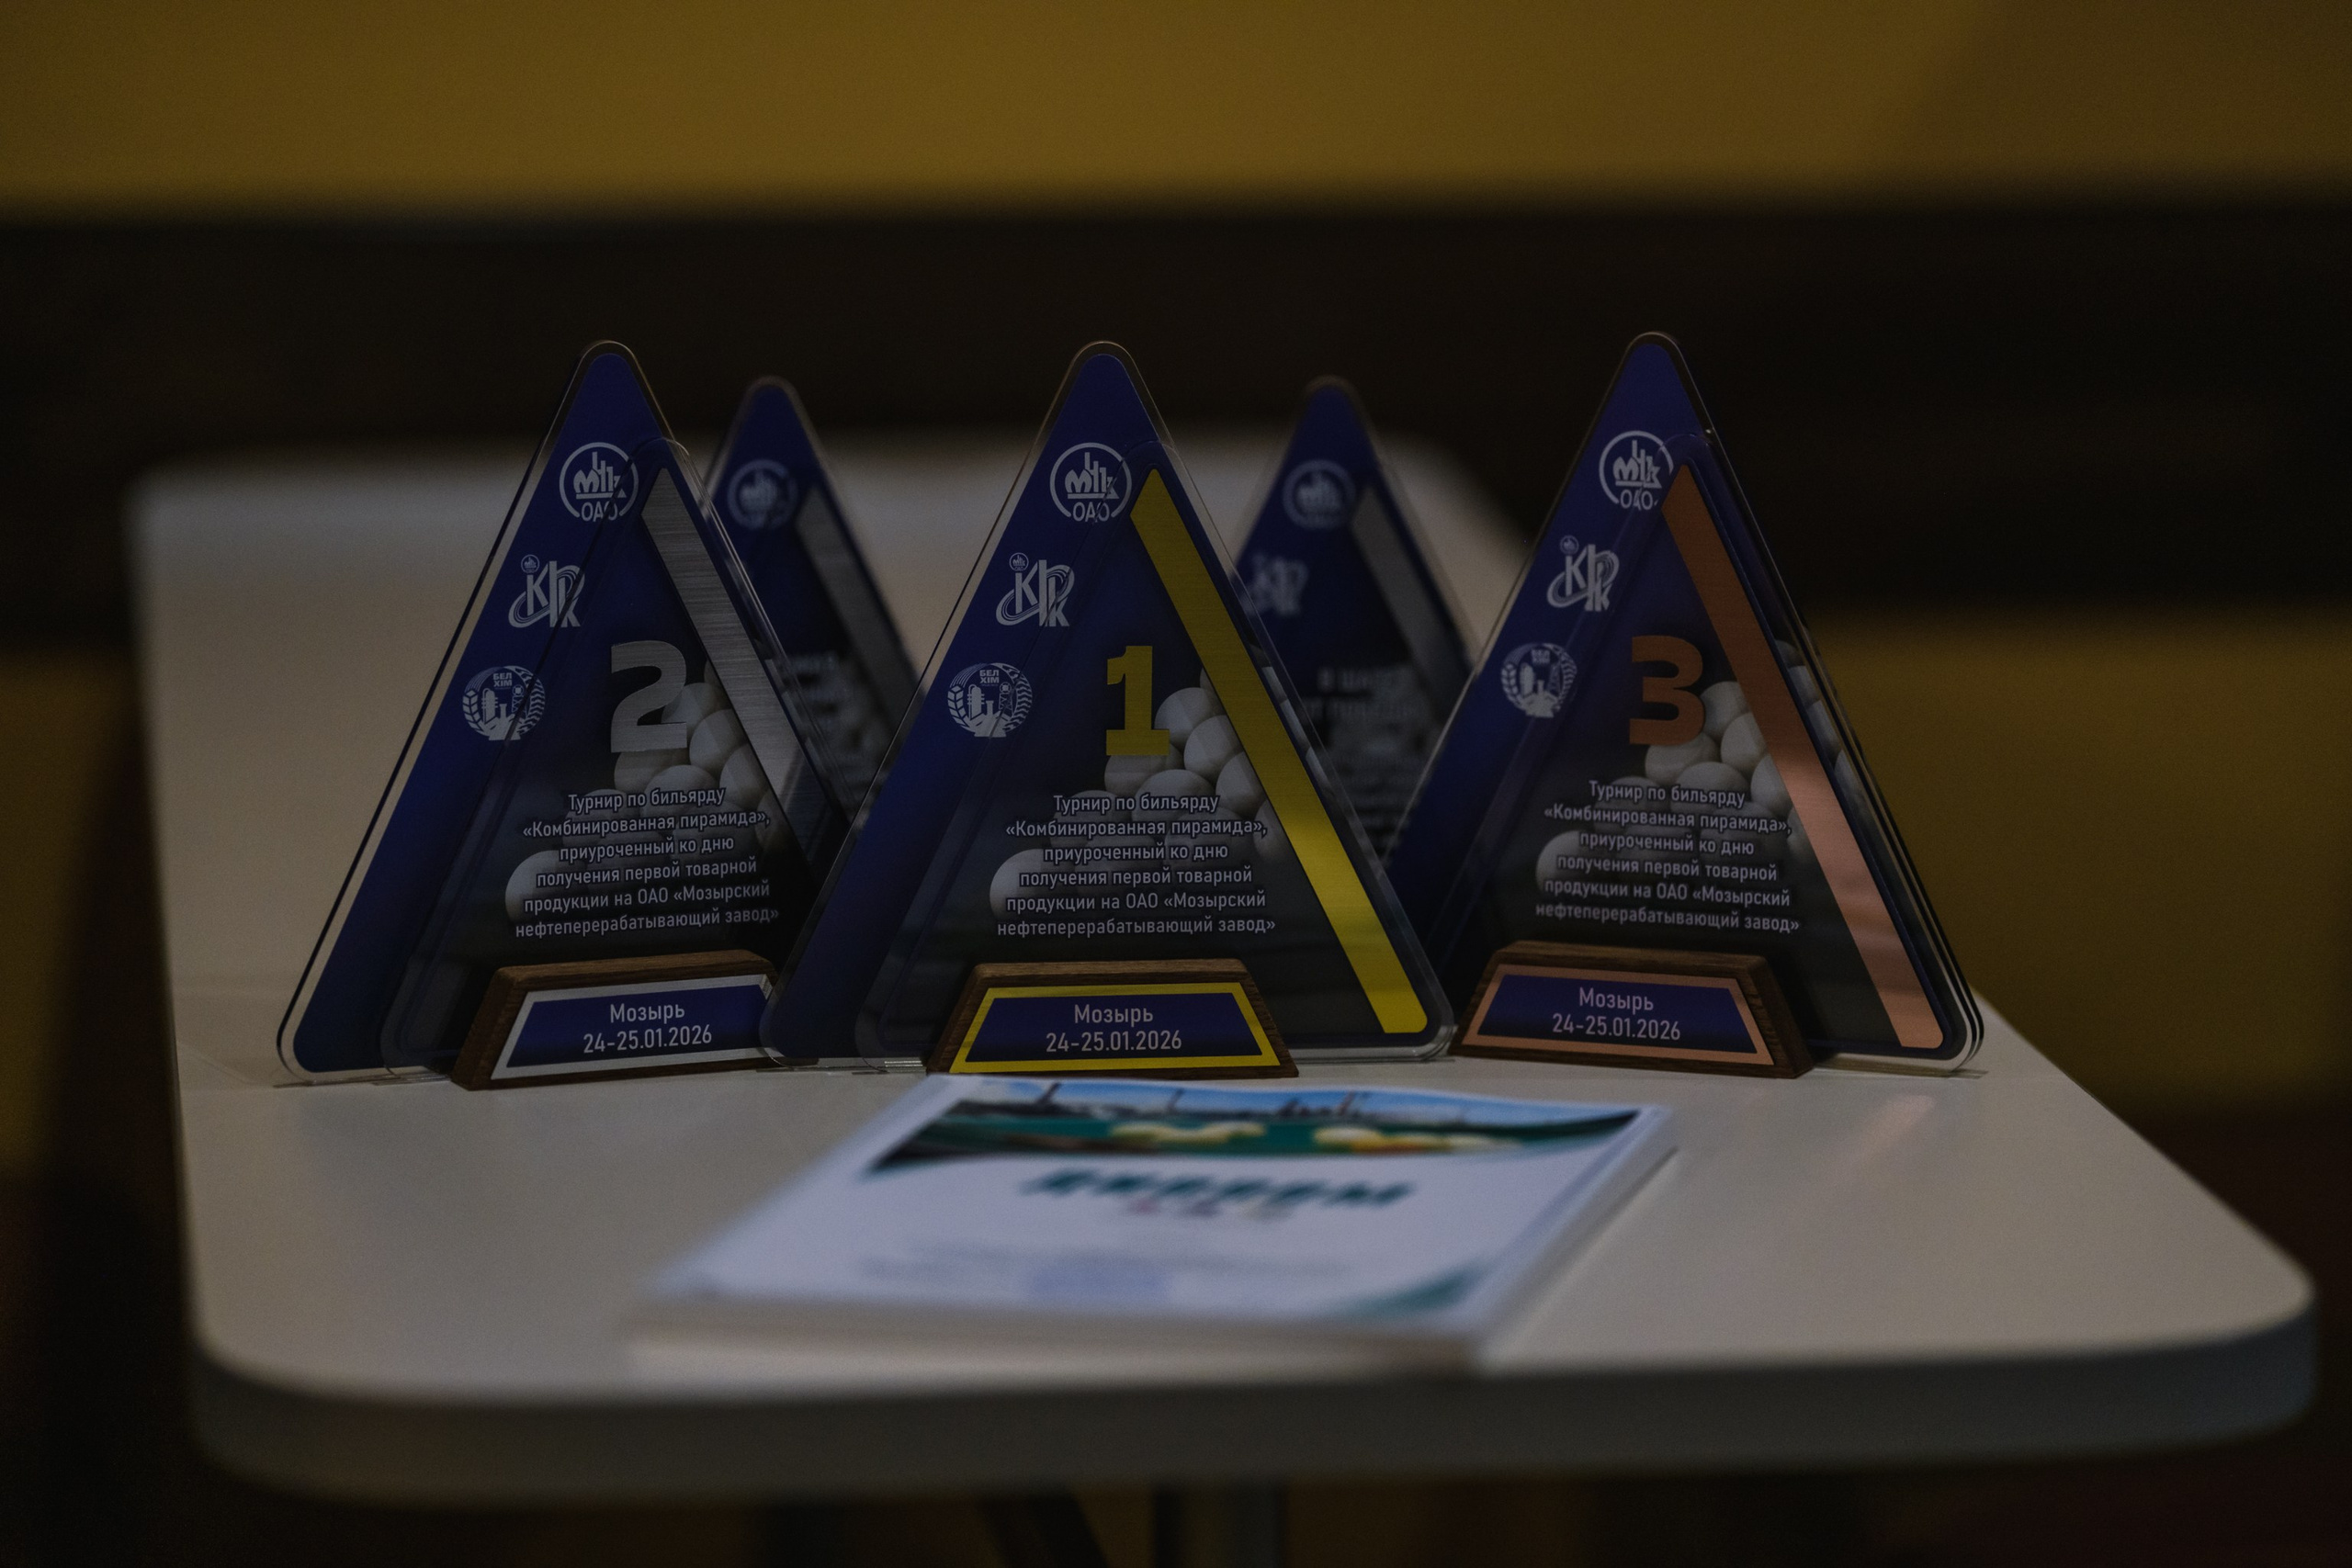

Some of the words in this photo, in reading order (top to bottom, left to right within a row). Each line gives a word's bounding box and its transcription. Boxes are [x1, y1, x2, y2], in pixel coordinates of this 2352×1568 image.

[611, 640, 688, 753] 2
[1106, 645, 1170, 756] 1
[1629, 635, 1706, 746] 3
[568, 793, 623, 816] Турнир
[628, 794, 646, 808] по
[650, 787, 726, 807] бильярду
[1054, 795, 1111, 815] Турнир
[1115, 797, 1135, 810] по
[1140, 792, 1219, 813] бильярду
[1589, 780, 1643, 803] Турнир
[1647, 786, 1666, 801] по
[1671, 784, 1745, 808] бильярду
[523, 814, 675, 838] «Комбинированная
[680, 810, 770, 832] пирамида»,
[1006, 818, 1166, 839] «Комбинированная
[1170, 818, 1268, 838] пирамида»,
[1544, 803, 1695, 827] «Комбинированная
[1700, 814, 1792, 835] пирамида»,
[560, 833, 674, 863] приуроченный
[679, 838, 696, 852] ко
[701, 837, 735, 854] дню
[1044, 841, 1165, 864] приуроченный
[1170, 846, 1188, 858] ко
[1193, 844, 1228, 860] дню
[1580, 830, 1693, 852] приуроченный
[1700, 840, 1716, 853] ко
[1721, 840, 1755, 856] дню
[537, 867, 620, 888] получения
[625, 857, 680, 883] первой
[684, 855, 757, 878] товарной
[1020, 872, 1107, 888] получения
[1112, 866, 1171, 887] первой
[1176, 864, 1252, 886] товарной
[1558, 855, 1639, 873] получения
[1645, 858, 1700, 878] первой
[1705, 863, 1777, 882] товарной
[524, 892, 609, 915] продукции
[614, 893, 632, 907] на
[638, 887, 668, 905] ОАО
[673, 879, 770, 902] «Мозырский
[1006, 896, 1095, 914] продукции
[1102, 896, 1120, 908] на
[1125, 893, 1159, 908] ОАО
[1163, 889, 1266, 909] «Мозырский
[1544, 879, 1628, 897] продукции
[1633, 886, 1652, 898] на
[1657, 884, 1688, 899] ОАО
[1692, 886, 1791, 908] «Мозырский
[514, 907, 720, 938] нефтеперерабатывающий
[725, 907, 779, 924] завод»
[997, 915, 1213, 938] нефтеперерабатывающий
[1218, 918, 1275, 933] завод»
[1535, 903, 1739, 929] нефтеперерабатывающий
[1744, 915, 1799, 933] завод»
[610, 1003, 685, 1024] Мозырь
[1579, 987, 1654, 1015] Мозырь
[1074, 1004, 1153, 1028] Мозырь
[1552, 1012, 1681, 1041] 24-25.01.2026
[583, 1024, 712, 1054] 24-25.01.2026
[1046, 1030, 1182, 1053] 24-25.01.2026
